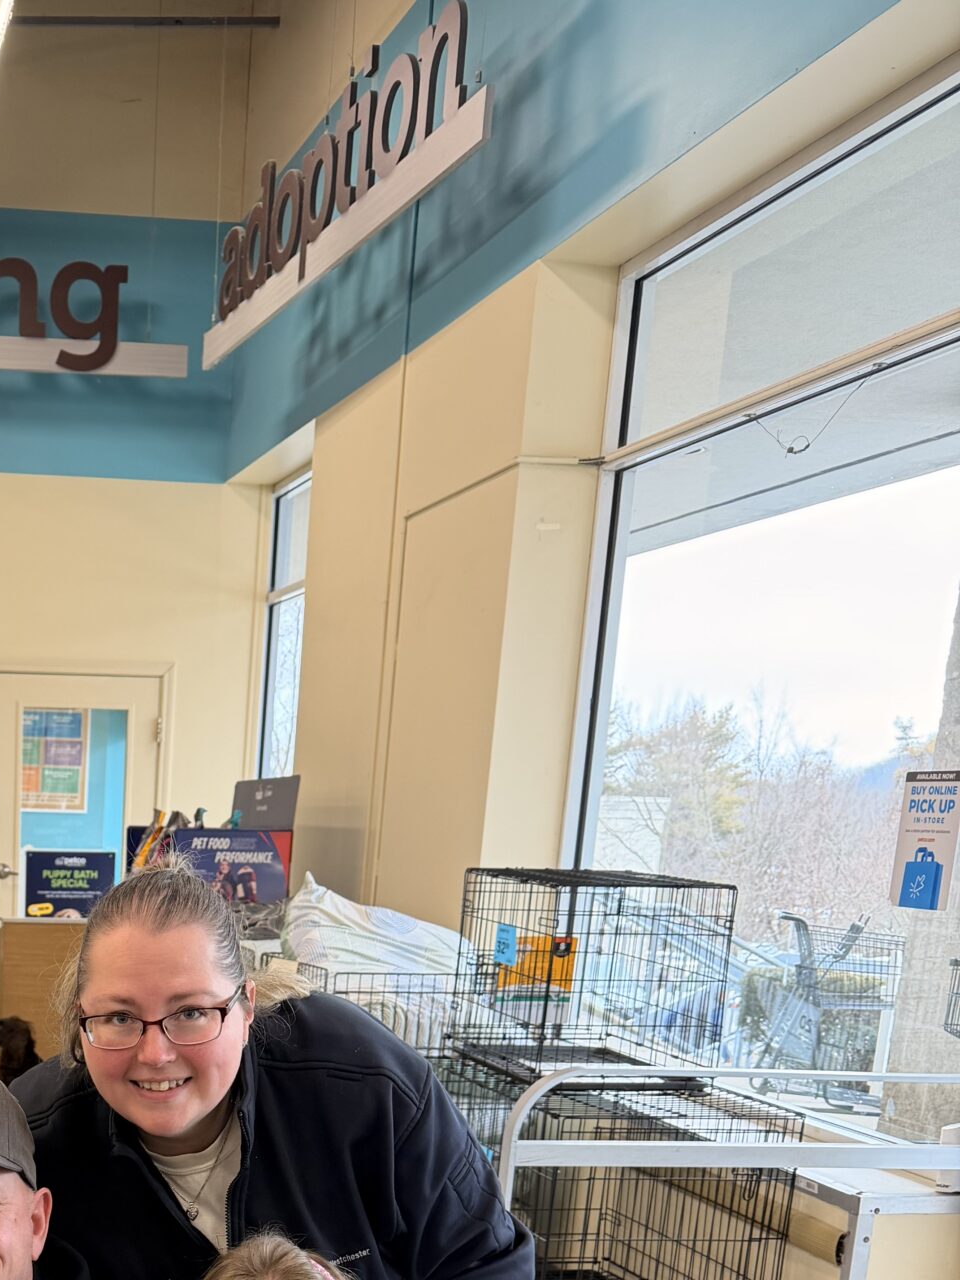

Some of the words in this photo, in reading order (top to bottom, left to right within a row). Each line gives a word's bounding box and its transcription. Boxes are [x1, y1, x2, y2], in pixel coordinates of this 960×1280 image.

[218, 0, 468, 322] adoption
[911, 786, 927, 795] BUY
[928, 785, 958, 795] ONLINE
[908, 799, 937, 814] PICK
[938, 799, 956, 814] UP
[192, 837, 207, 849] PET
[207, 838, 231, 849] FOOD
[64, 856, 86, 865] petco
[214, 851, 273, 864] PERFORMANCE
[42, 869, 72, 879] PUPPY
[73, 870, 98, 879] BATH
[51, 879, 89, 888] SPECIAL
